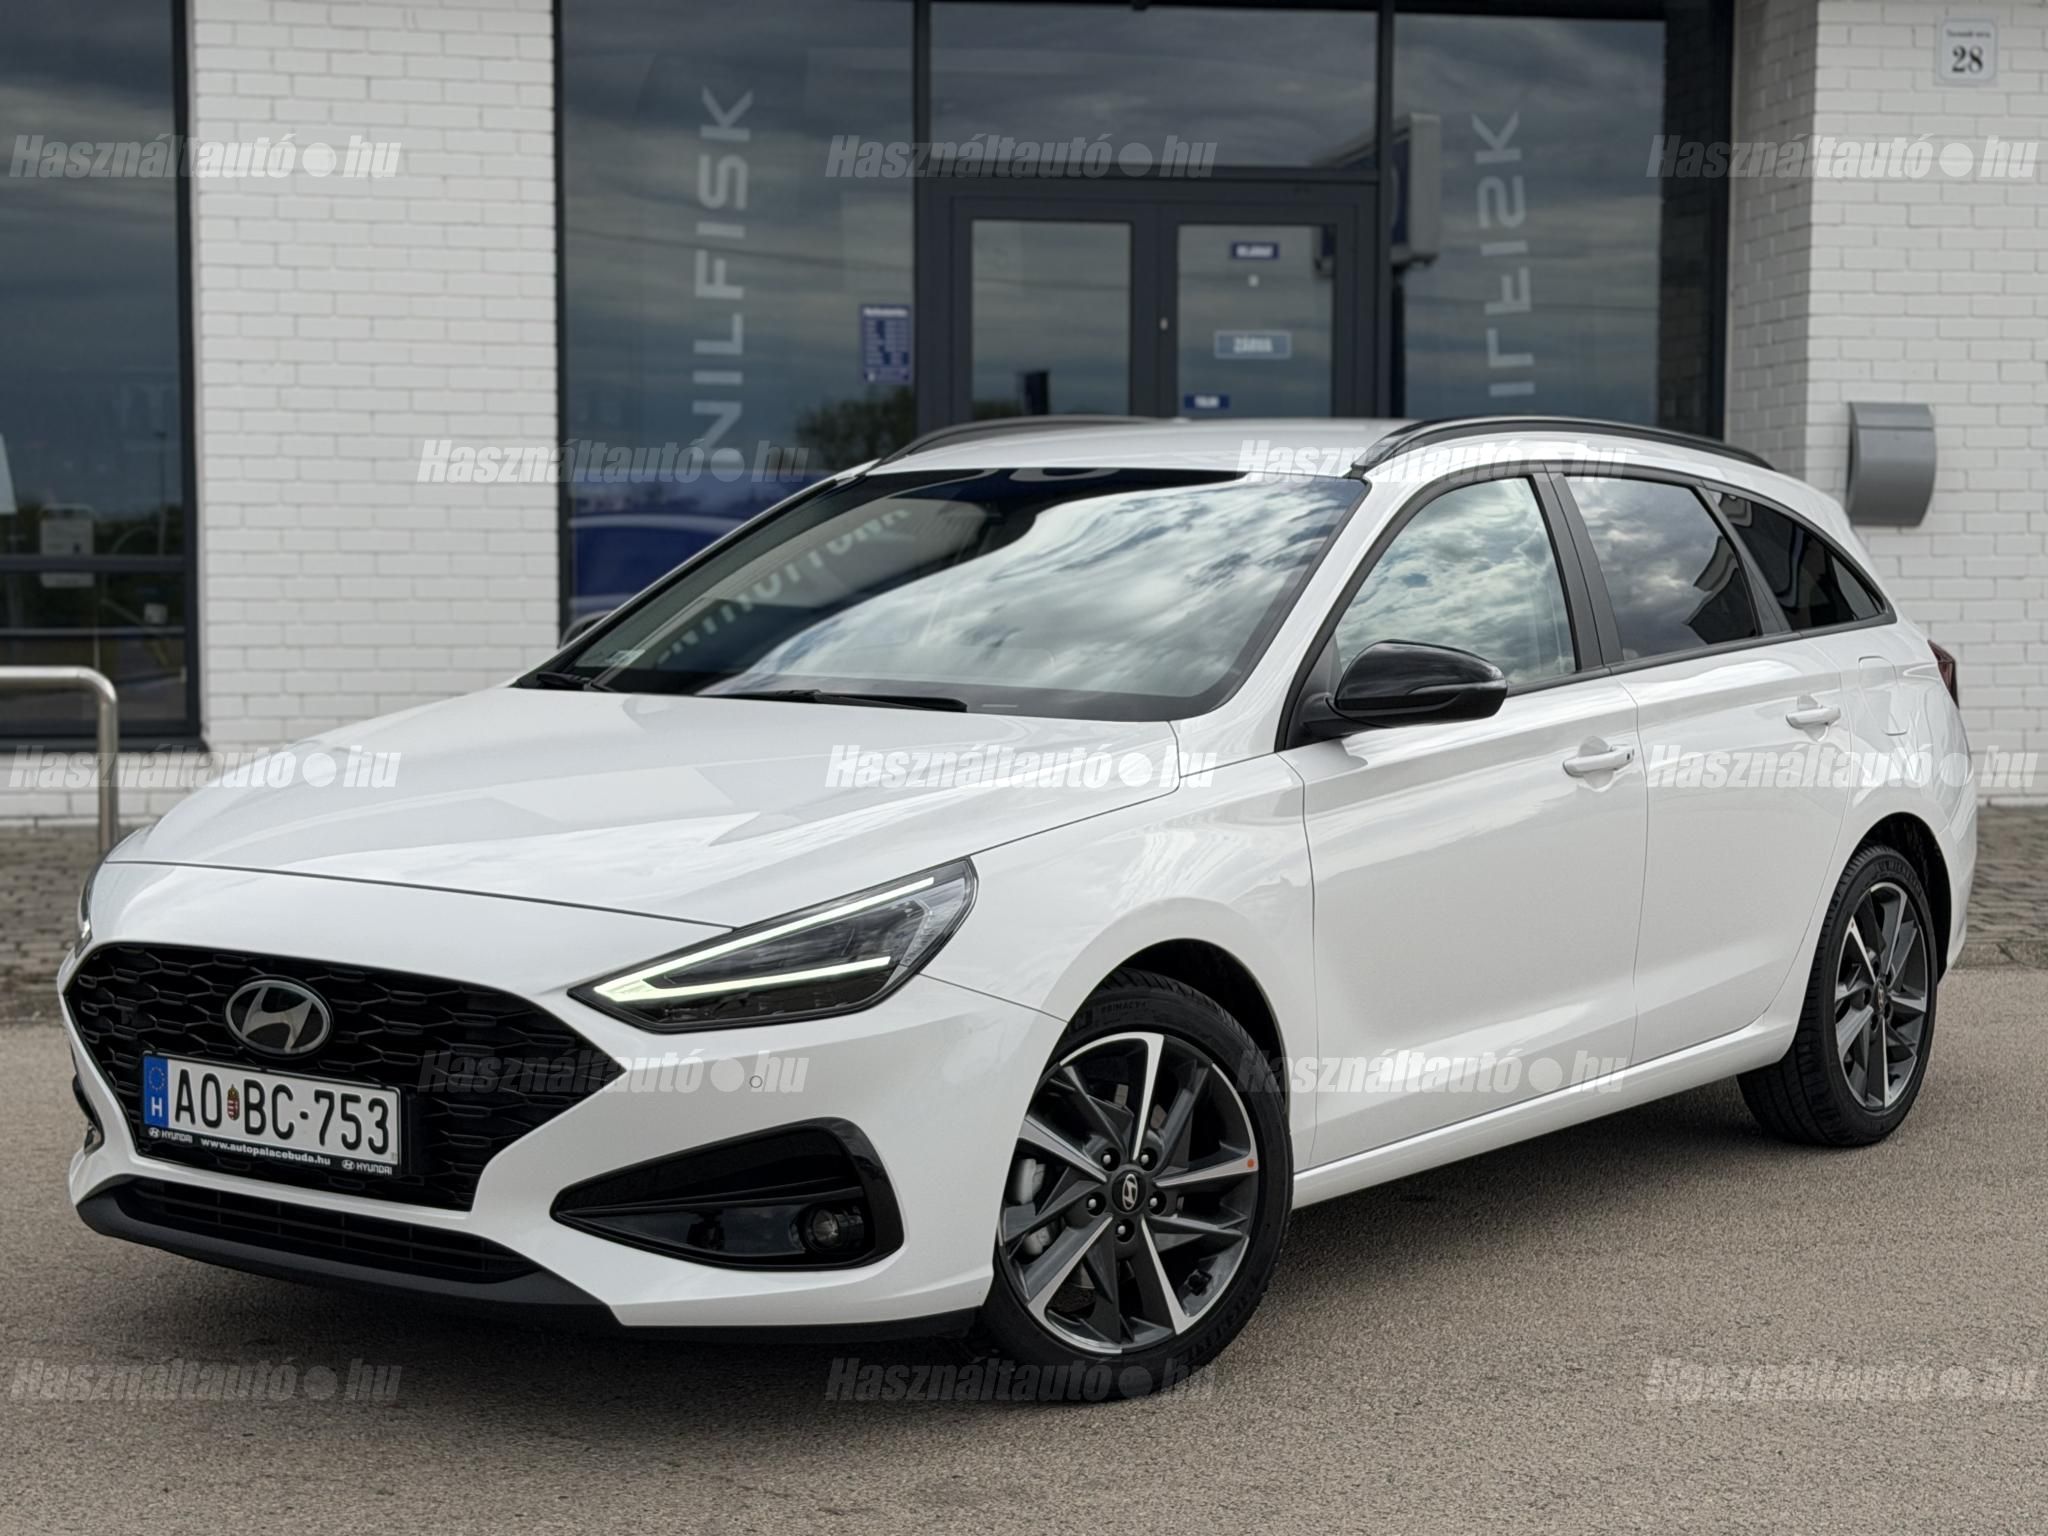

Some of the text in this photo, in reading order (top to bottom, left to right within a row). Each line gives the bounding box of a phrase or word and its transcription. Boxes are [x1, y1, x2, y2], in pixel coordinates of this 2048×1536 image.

[1952, 46, 1984, 73] 28
[692, 87, 754, 460] NILFISK
[151, 1096, 163, 1118] H
[174, 1068, 222, 1129] AO
[161, 1130, 193, 1144] HYUNDAI
[200, 1138, 331, 1166] www.autopalacebuda.hu
[356, 1162, 393, 1176] HYUNDAI
